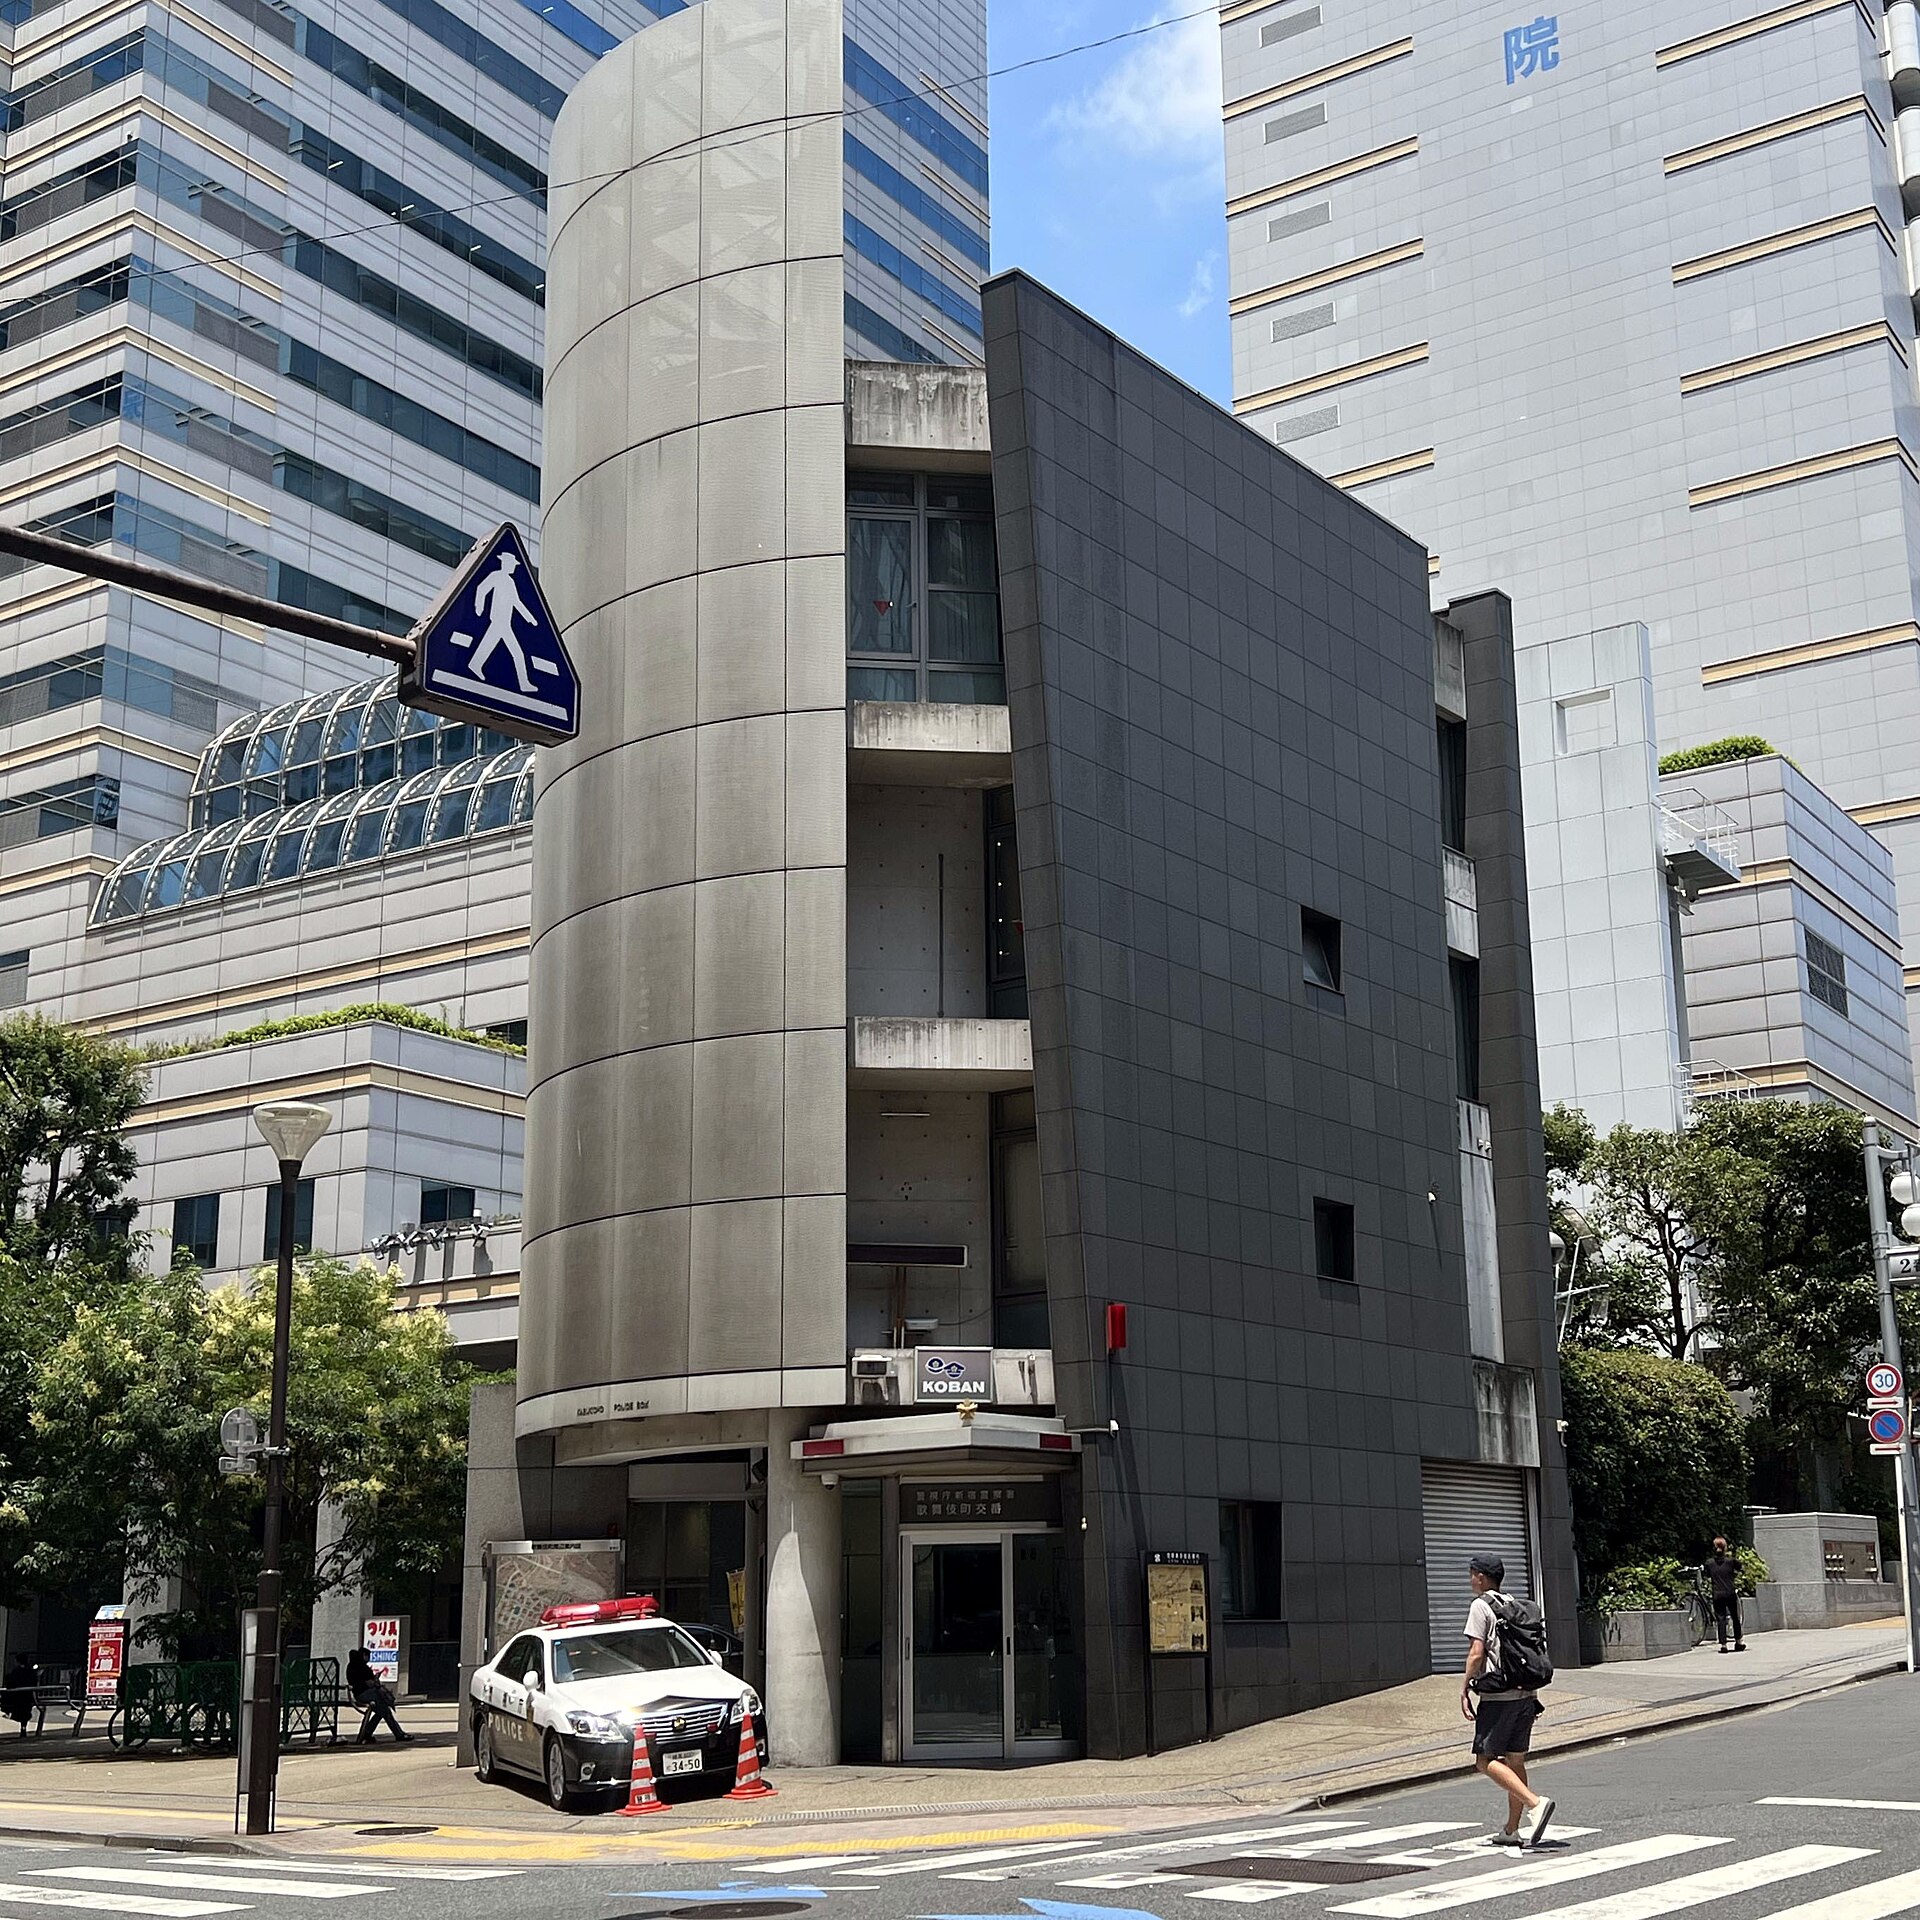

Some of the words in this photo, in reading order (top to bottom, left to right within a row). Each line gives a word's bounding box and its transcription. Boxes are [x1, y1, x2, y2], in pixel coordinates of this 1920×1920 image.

[1504, 15, 1559, 85] 院
[922, 1381, 985, 1393] KOBAN
[1875, 1373, 1893, 1388] 30
[488, 1711, 524, 1741] POLICE
[671, 1758, 701, 1772] 34-50
